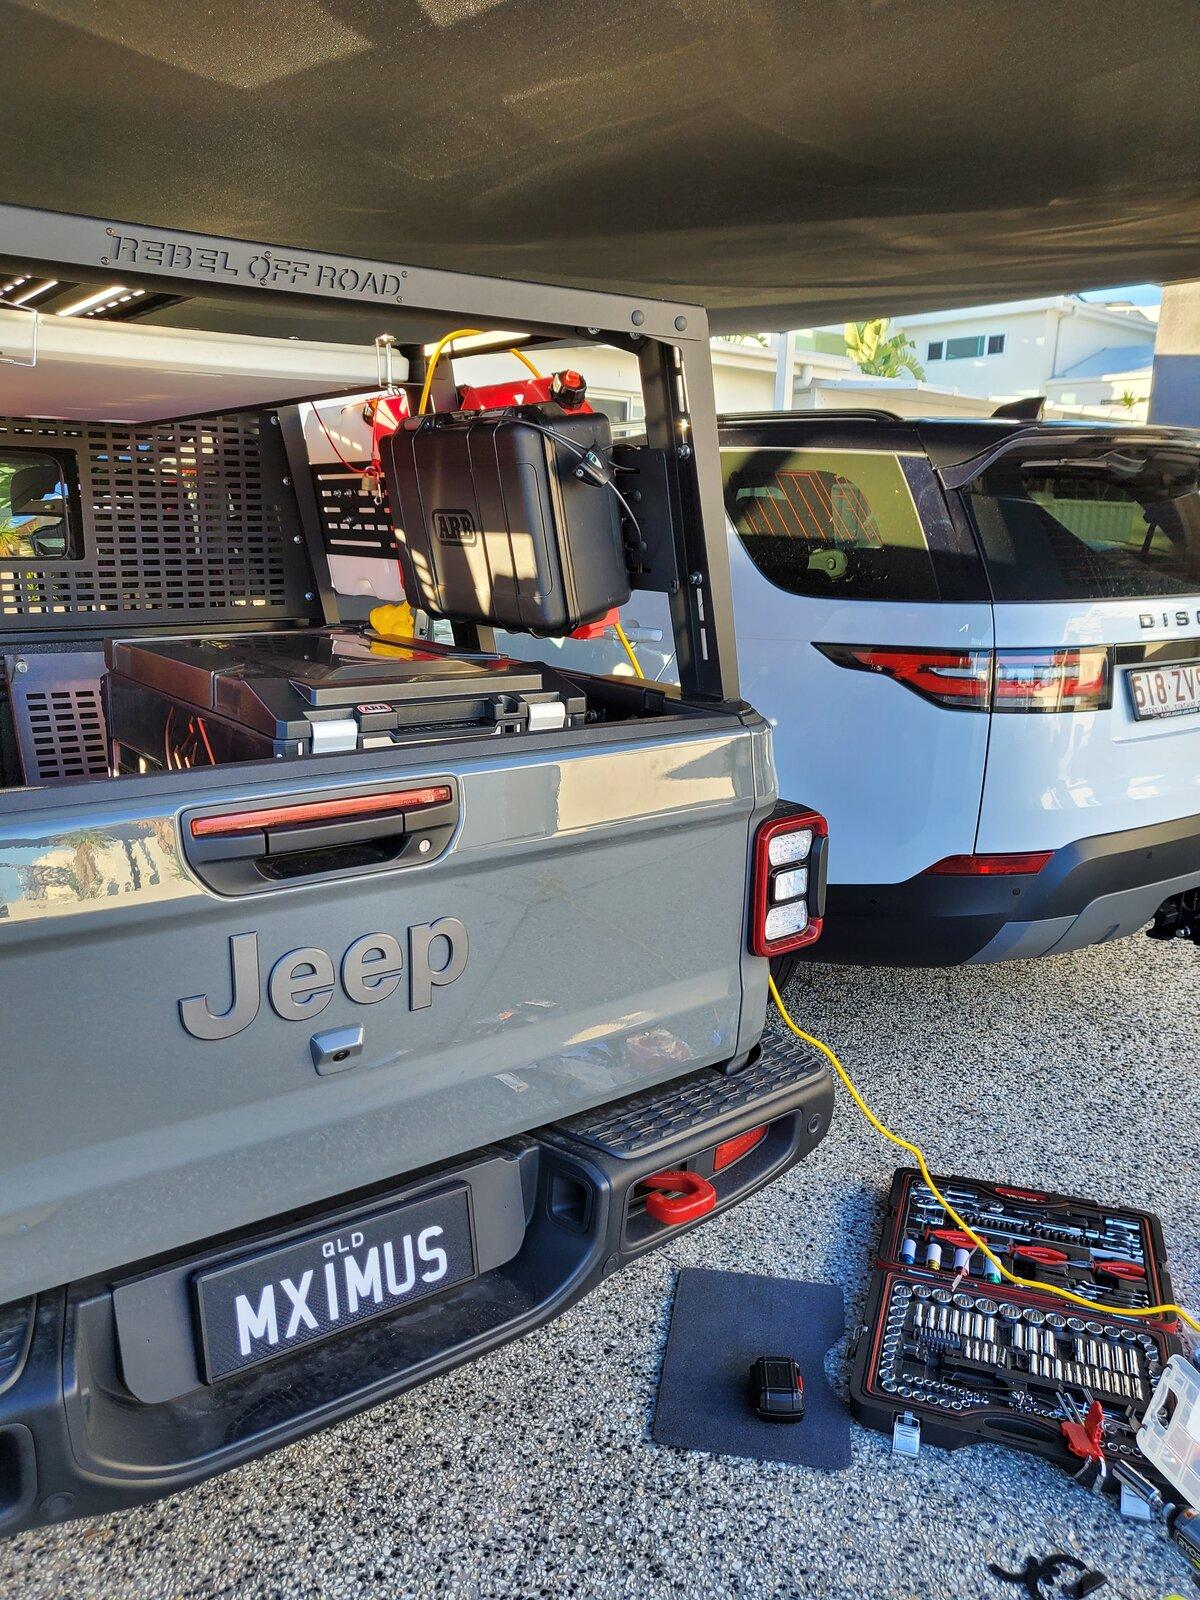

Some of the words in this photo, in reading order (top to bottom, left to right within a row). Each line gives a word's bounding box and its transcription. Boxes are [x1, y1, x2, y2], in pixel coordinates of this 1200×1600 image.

[111, 235, 239, 277] REBEL
[248, 254, 310, 284] OFF
[315, 264, 401, 297] ROAD
[438, 516, 474, 539] ARB
[362, 703, 387, 713] ARB
[178, 916, 470, 1041] Jeep
[322, 1231, 364, 1258] QLD
[235, 1225, 448, 1356] MXIMUS
